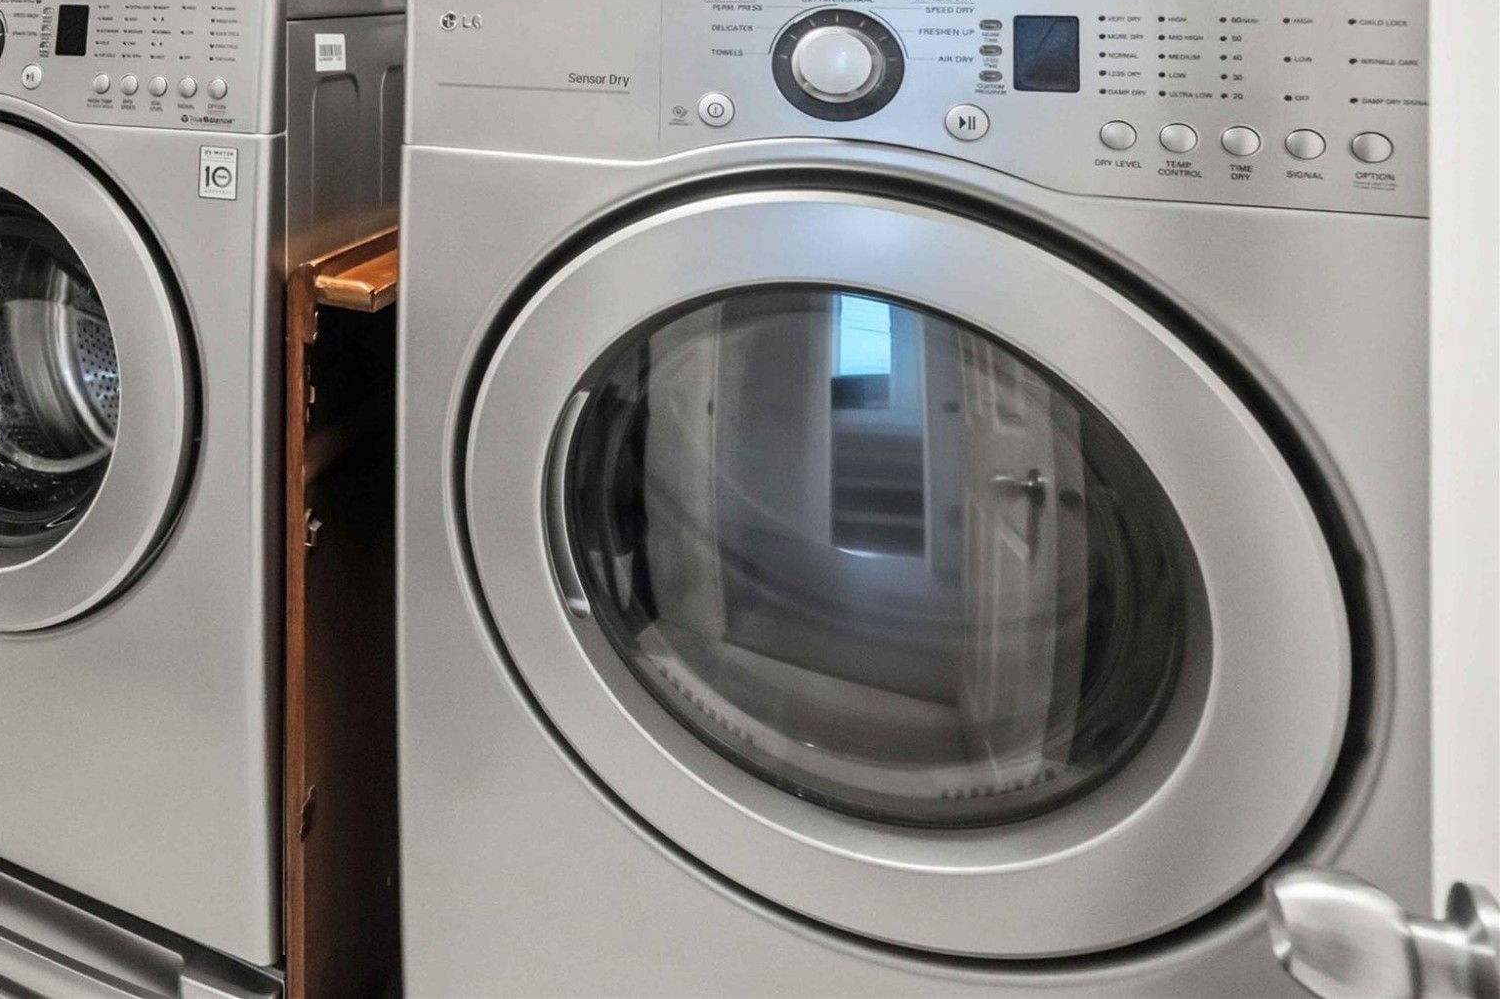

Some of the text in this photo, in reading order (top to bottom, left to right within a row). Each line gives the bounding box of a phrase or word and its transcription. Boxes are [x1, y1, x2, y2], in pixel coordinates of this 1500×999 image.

[925, 6, 975, 14] SPEED DRY
[462, 13, 484, 30] LG
[919, 28, 960, 36] FRESHEN
[938, 55, 975, 63] AIR DRY
[568, 72, 630, 88] Sensor Dry
[1094, 158, 1142, 169] DRY LEVEL
[1230, 164, 1253, 173] TIME
[1157, 168, 1203, 179] CONTROL
[1231, 172, 1251, 181] DRY
[1286, 170, 1324, 180] SIGNAL
[1355, 171, 1396, 181] OPTION
